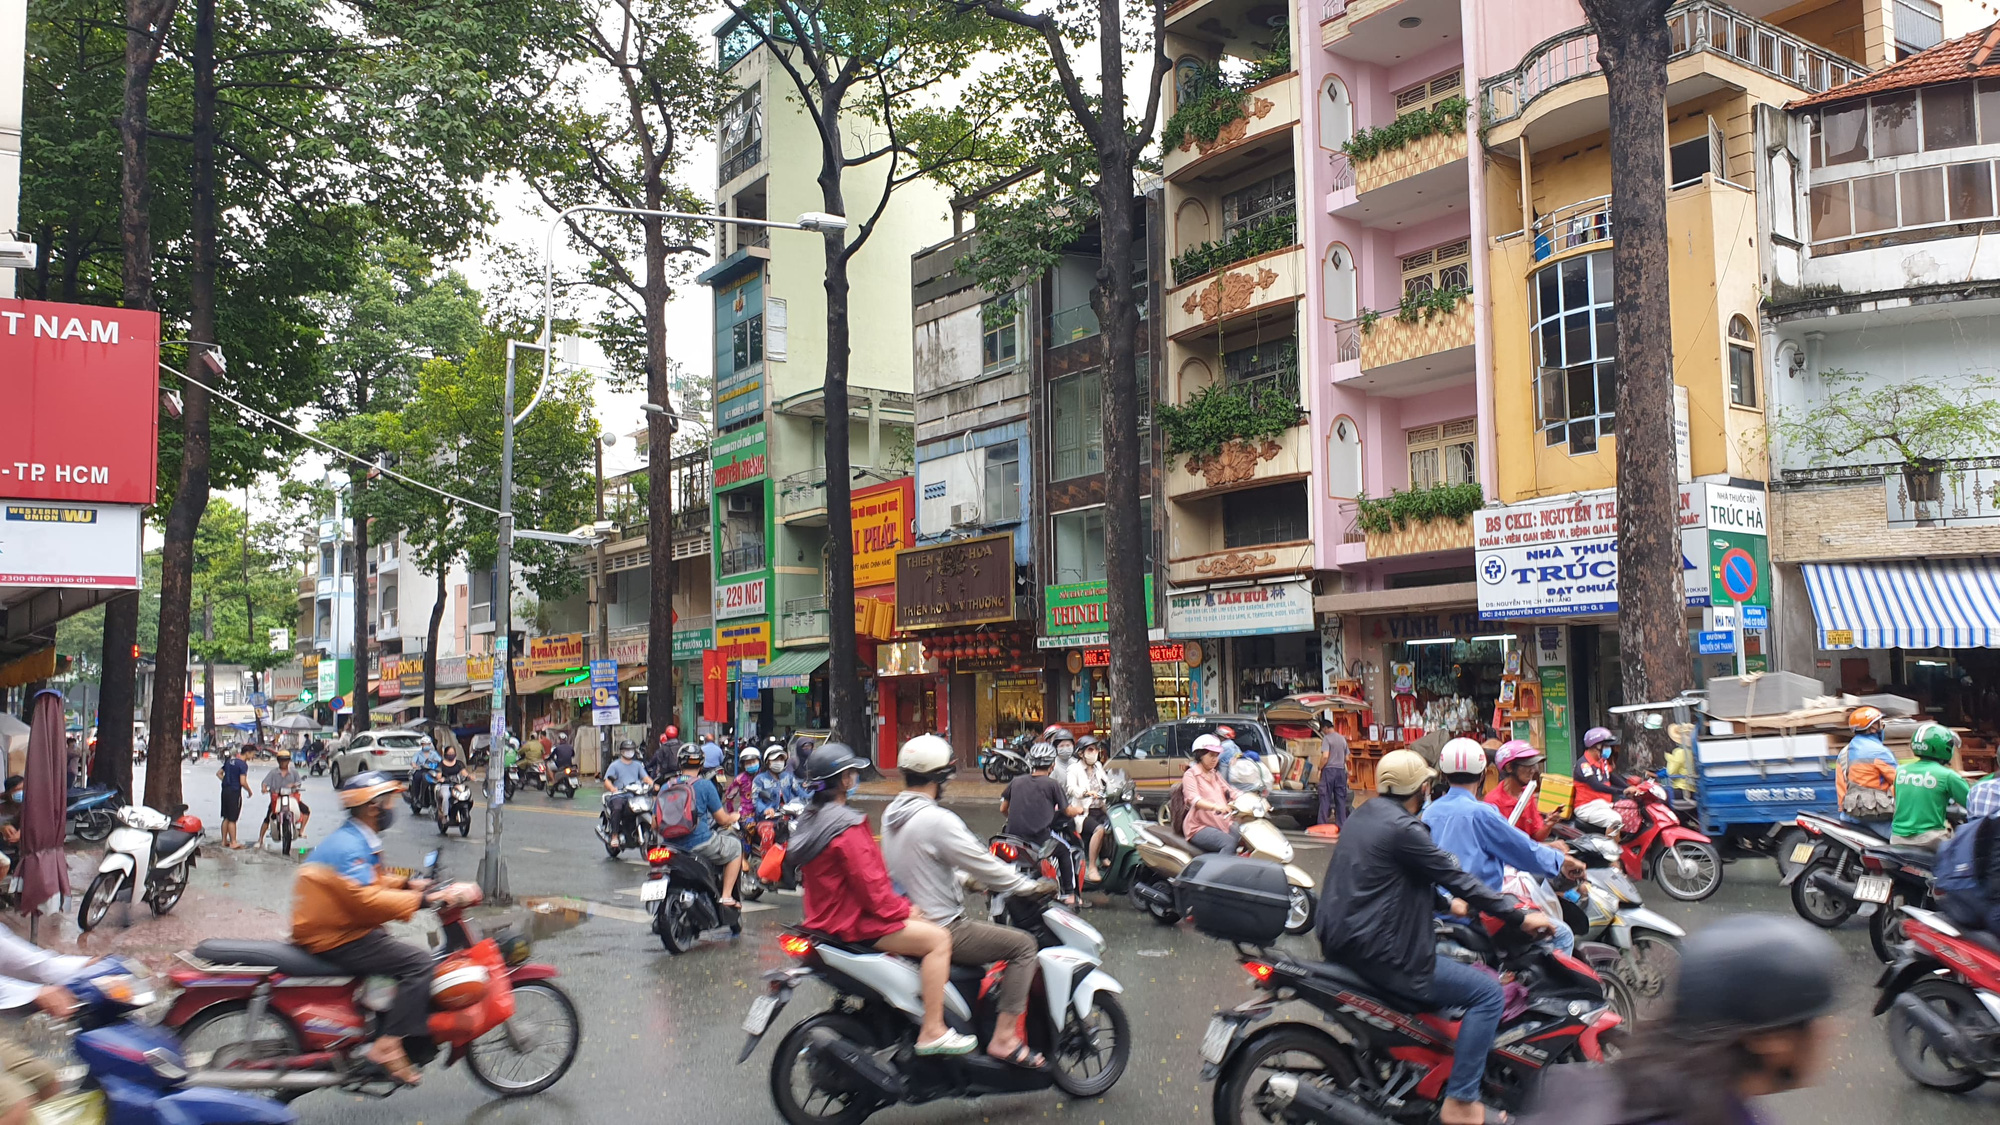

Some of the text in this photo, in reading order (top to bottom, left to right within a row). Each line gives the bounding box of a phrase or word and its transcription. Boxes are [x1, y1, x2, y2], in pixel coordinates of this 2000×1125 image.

[33, 314, 119, 344] NAM
[55, 464, 109, 484] HCM
[1717, 491, 1728, 500] NHÀ
[9, 507, 58, 515] WESTERN
[1485, 516, 1501, 533] BS
[1540, 500, 1591, 526] NGUYỄN
[1710, 503, 1764, 529] TRÚC HÀ
[863, 515, 897, 554] PHÁT
[1505, 533, 1521, 545] VIÊM
[1523, 534, 1539, 543] GAN
[1593, 524, 1610, 536] GAN
[906, 551, 934, 569] THIÊN
[1526, 546, 1564, 561] NHÀ
[1511, 555, 1617, 584] TRÚC
[27, 575, 51, 583] điểm
[54, 576, 74, 585] giao
[76, 576, 96, 585] dịch
[726, 581, 763, 609] 229 NCT
[1172, 598, 1190, 609] ĐIỆN
[1218, 589, 1242, 605] LÂM
[1547, 586, 1573, 598] ĐẠT
[1052, 602, 1099, 629] THỊNH
[1506, 607, 1533, 616] NGUYỄN
[682, 638, 702, 650] PHƯỜNG
[704, 638, 711, 648] 12
[1706, 632, 1726, 641] ĐƯỜNG
[617, 646, 638, 657] SANH
[1545, 651, 1558, 661] HÀ
[594, 687, 609, 707] 9
[1911, 740, 1929, 751] Grab
[1895, 769, 1938, 789] Grab
